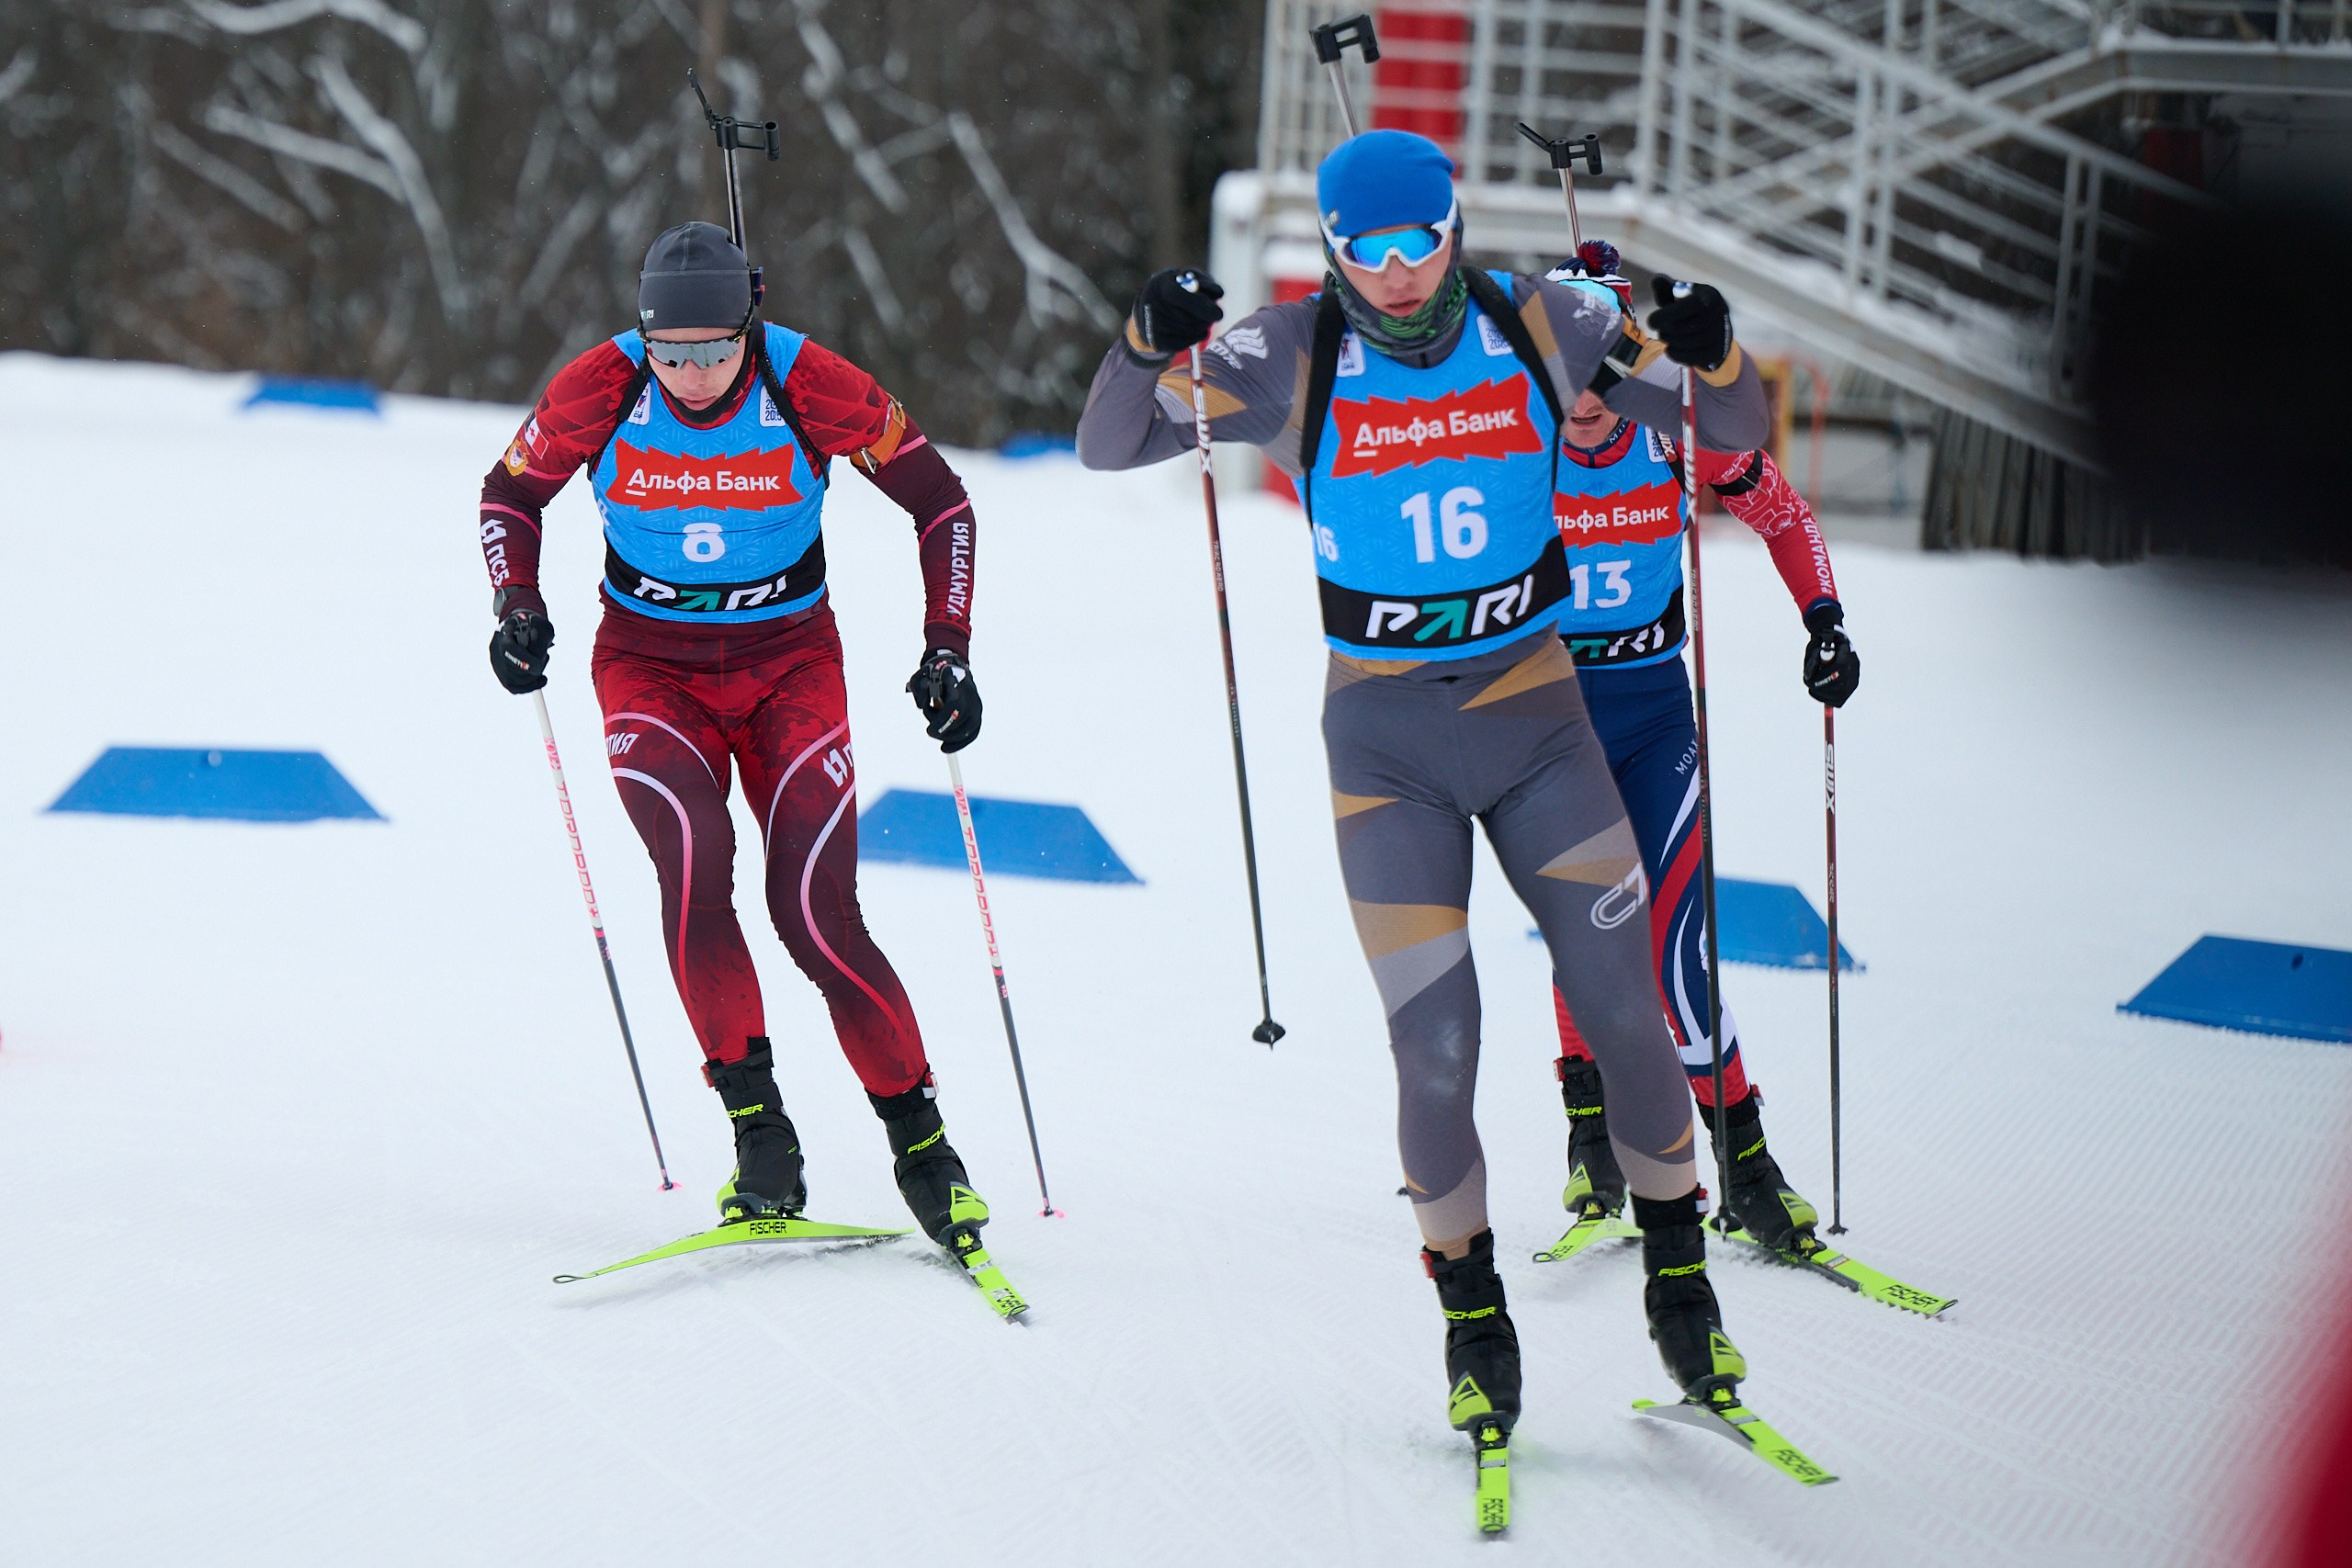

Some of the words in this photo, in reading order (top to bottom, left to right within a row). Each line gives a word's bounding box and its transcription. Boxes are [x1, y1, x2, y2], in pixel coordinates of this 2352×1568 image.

[1352, 417, 1446, 456] Альфа
[1448, 408, 1519, 436] Банк
[626, 468, 711, 496] Альфа
[717, 470, 780, 491] Банк
[1400, 486, 1487, 564] 16
[1553, 509, 1608, 534] льфа
[1612, 506, 1669, 527] Банк
[683, 522, 726, 563] 8
[1312, 523, 1339, 562] 16
[945, 522, 969, 617] УДМУРТИЯ
[1569, 559, 1632, 611] 13
[633, 575, 787, 611] PARI
[1365, 574, 1534, 642] PARI
[1567, 620, 1665, 659] ARI
[727, 1103, 763, 1119] CHER
[1565, 1106, 1602, 1117] CHER
[750, 1221, 787, 1235] FISCHER
[1880, 1284, 1939, 1308] FISCHER
